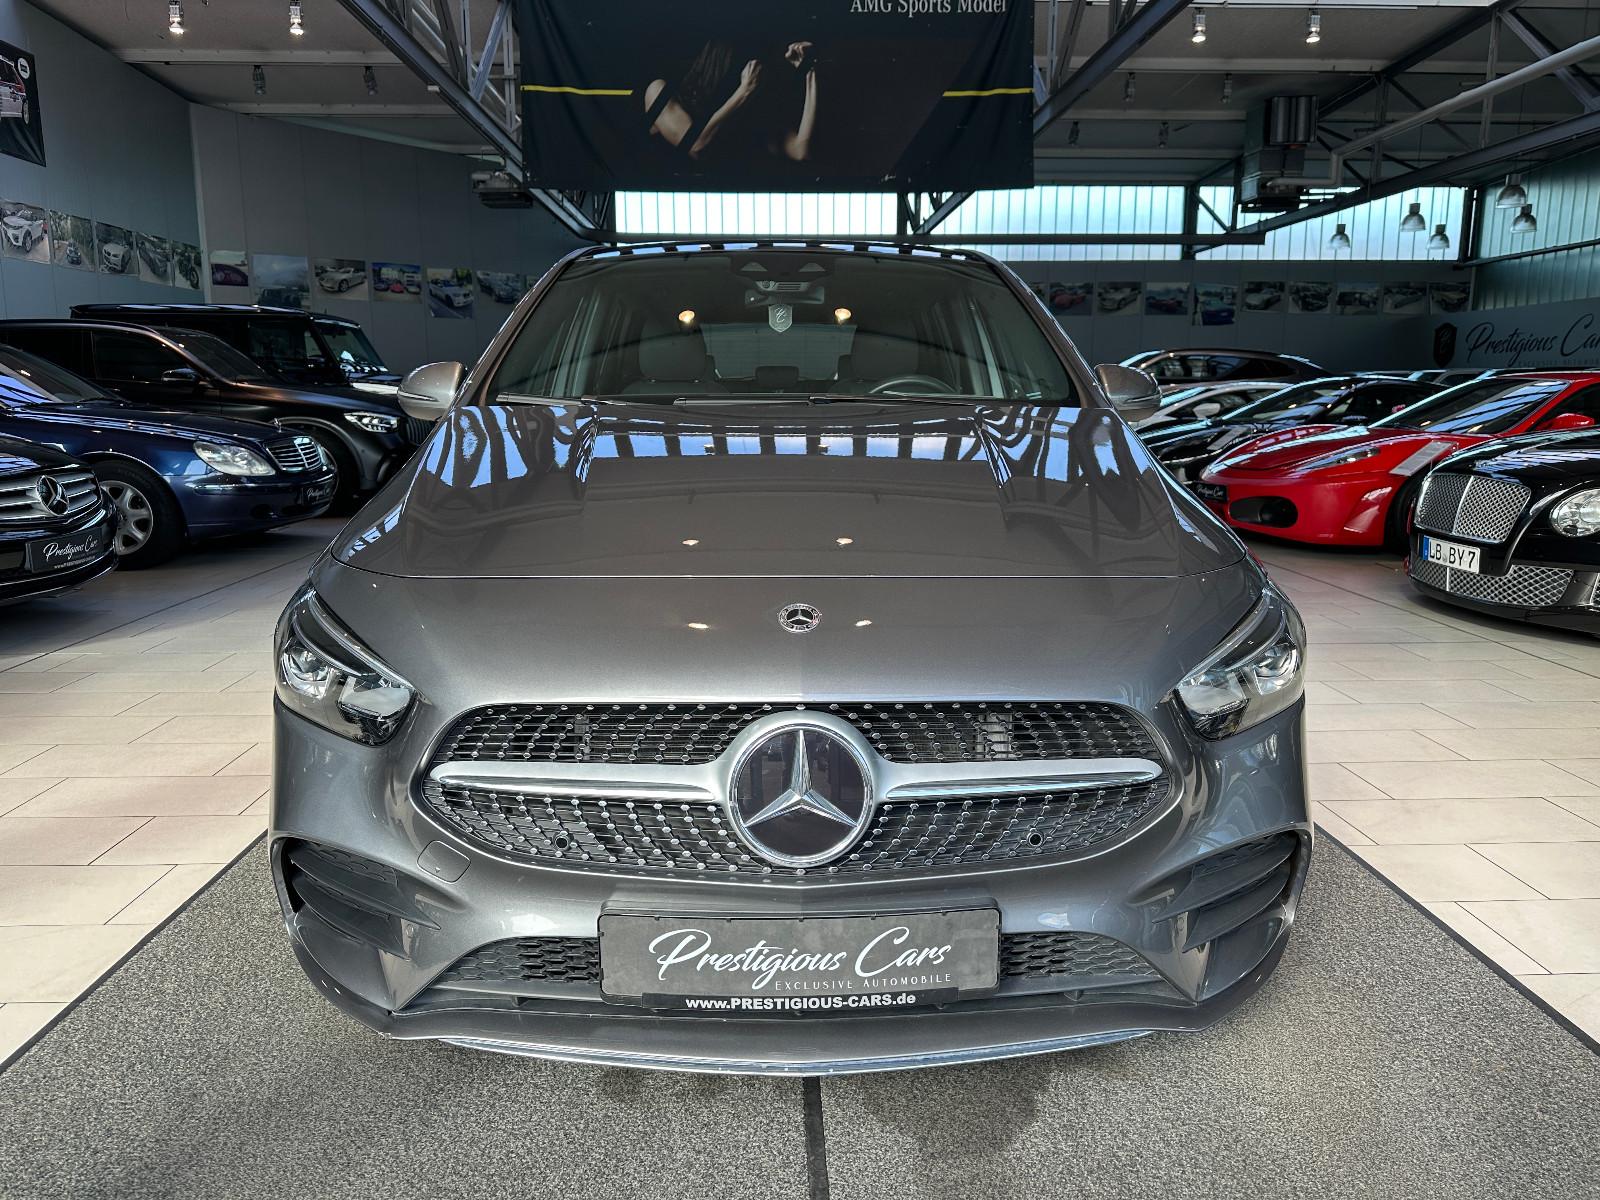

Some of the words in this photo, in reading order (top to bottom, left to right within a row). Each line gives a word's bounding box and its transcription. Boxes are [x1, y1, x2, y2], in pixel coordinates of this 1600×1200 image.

[850, 0, 892, 13] AMG
[898, 0, 951, 18] Sports
[957, 0, 1006, 13] Model
[1466, 322, 1558, 367] Prestigious
[1430, 541, 1442, 560] LB
[1449, 546, 1465, 567] BY
[1468, 551, 1476, 569] 7
[649, 928, 847, 990] Prestigious
[855, 926, 952, 978] Cars
[775, 980, 853, 991] EXCLUSIVE
[863, 973, 951, 988] AUTOMOBILE
[685, 993, 917, 1010] www.PRESTIGIOUS-CARS.de
